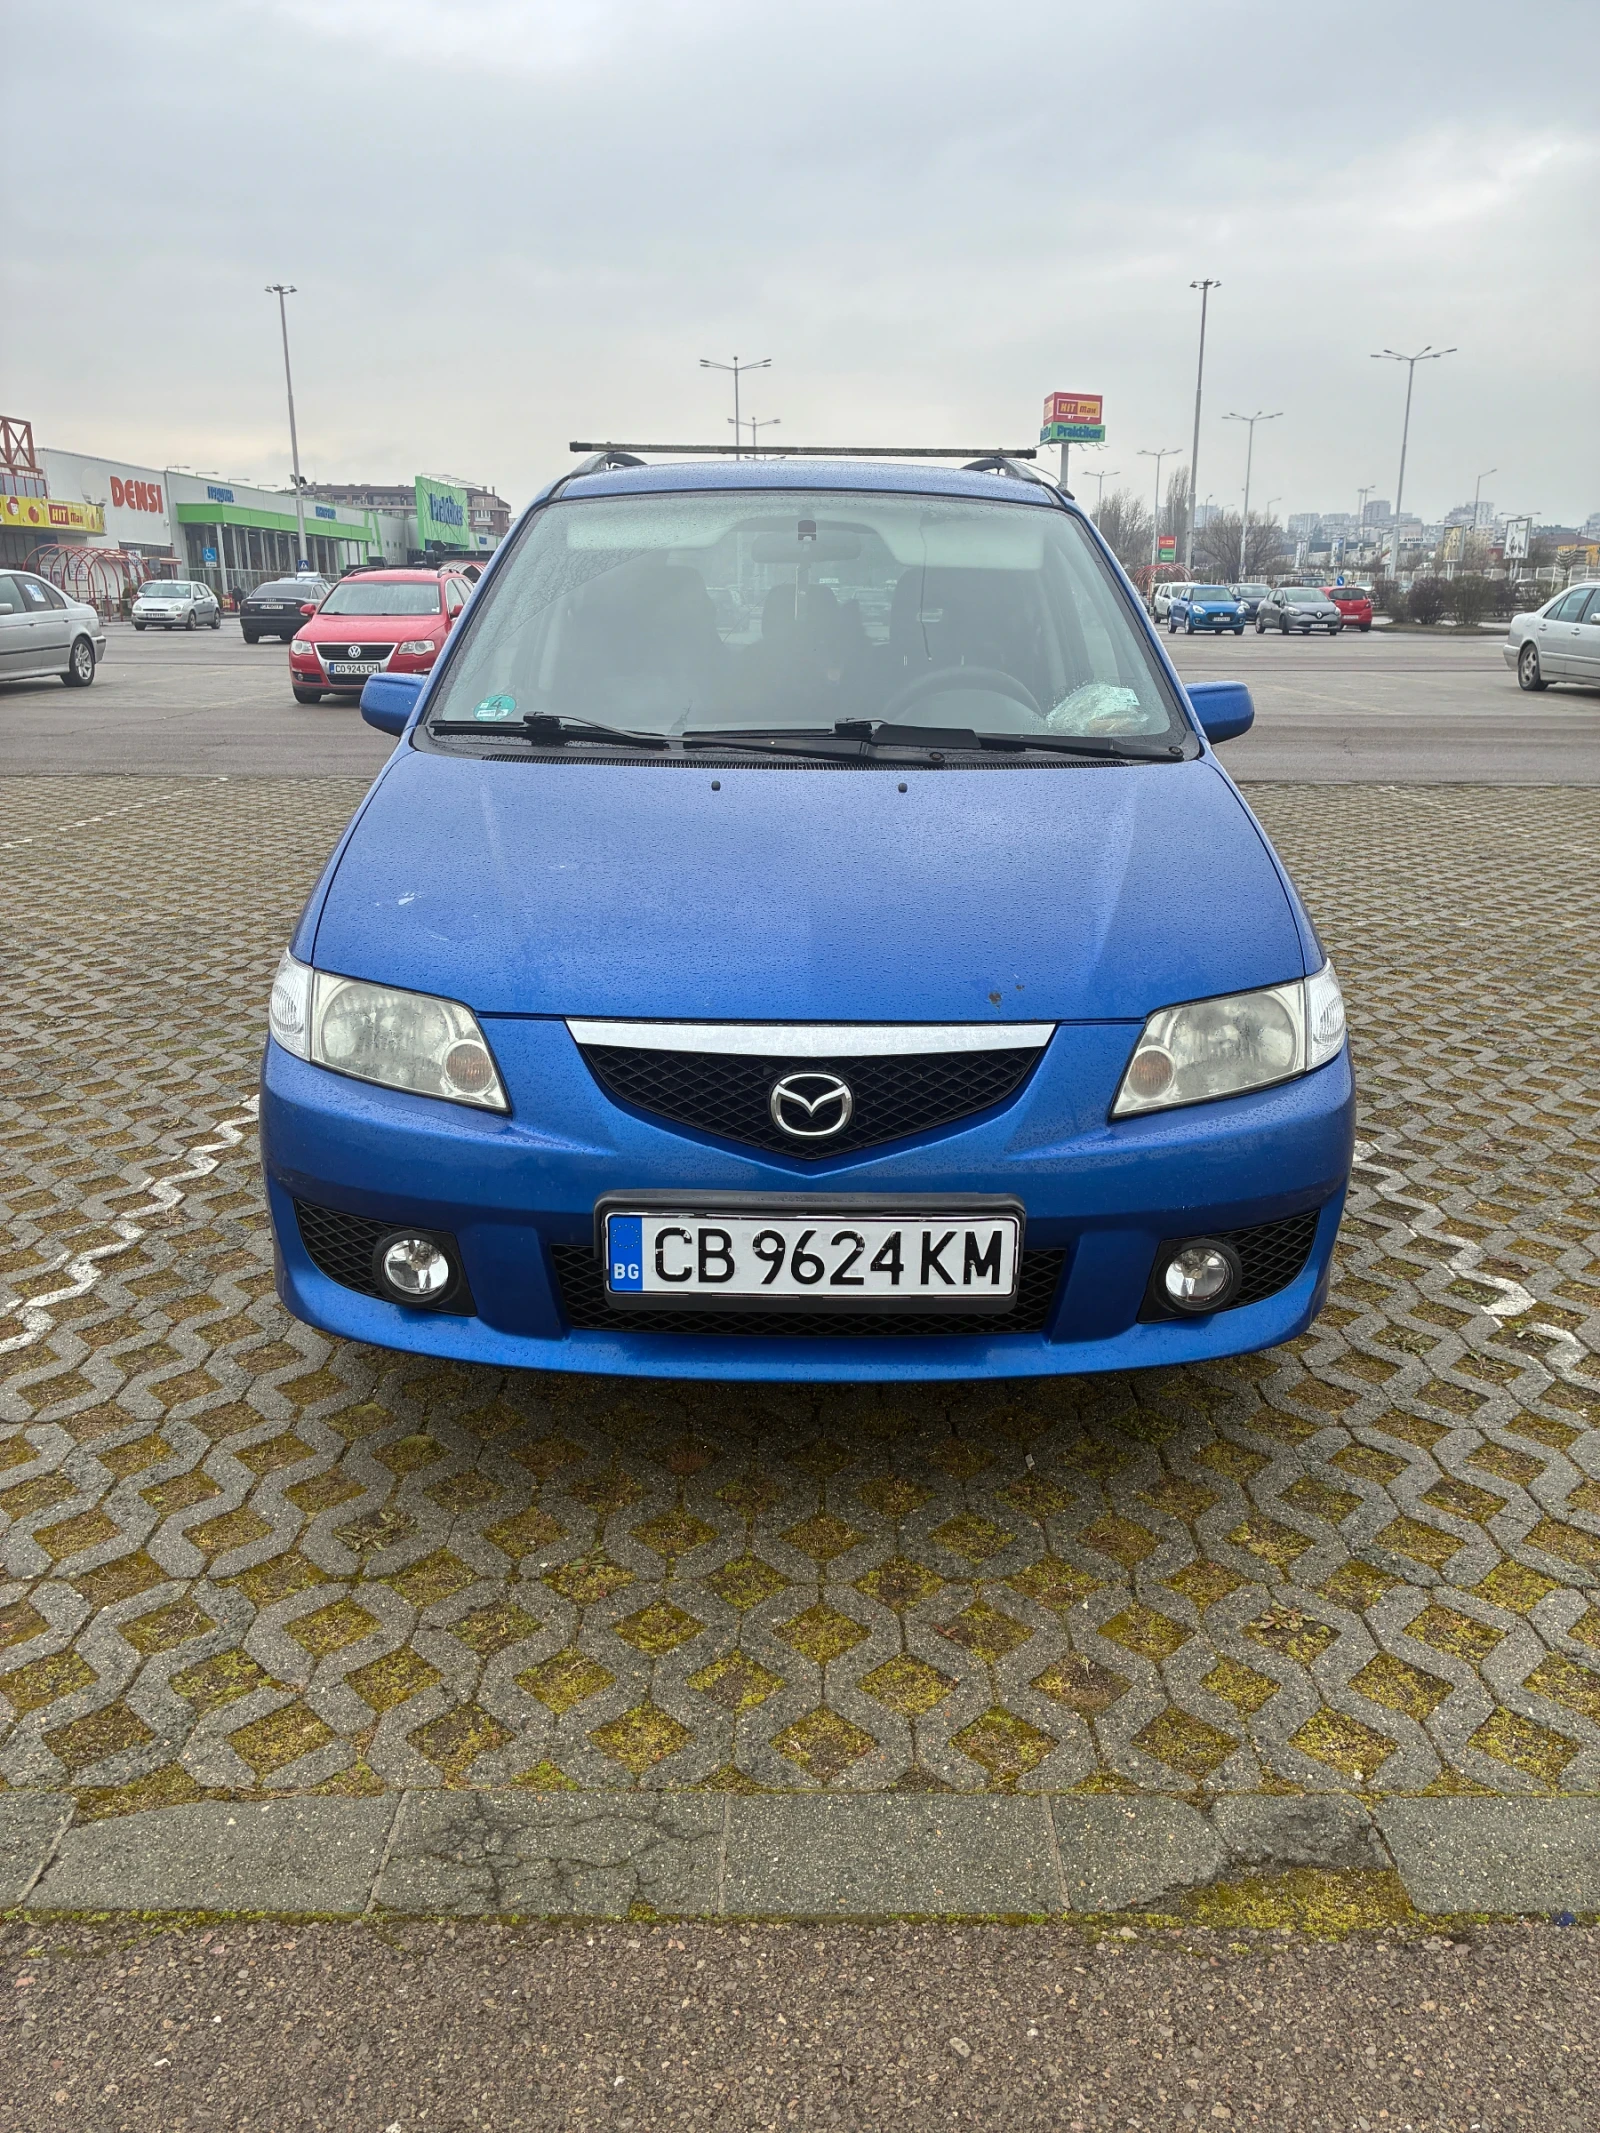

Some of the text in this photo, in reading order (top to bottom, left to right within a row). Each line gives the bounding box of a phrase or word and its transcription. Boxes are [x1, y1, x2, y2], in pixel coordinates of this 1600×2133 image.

[1060, 403, 1076, 412] HIT
[1057, 425, 1102, 439] Praktiker
[110, 476, 164, 514] DENSI
[51, 508, 67, 522] HIT
[347, 665, 366, 673] 9243
[367, 665, 378, 673] CH
[654, 1226, 1003, 1286] CB 9624 KM
[613, 1263, 639, 1279] BG
